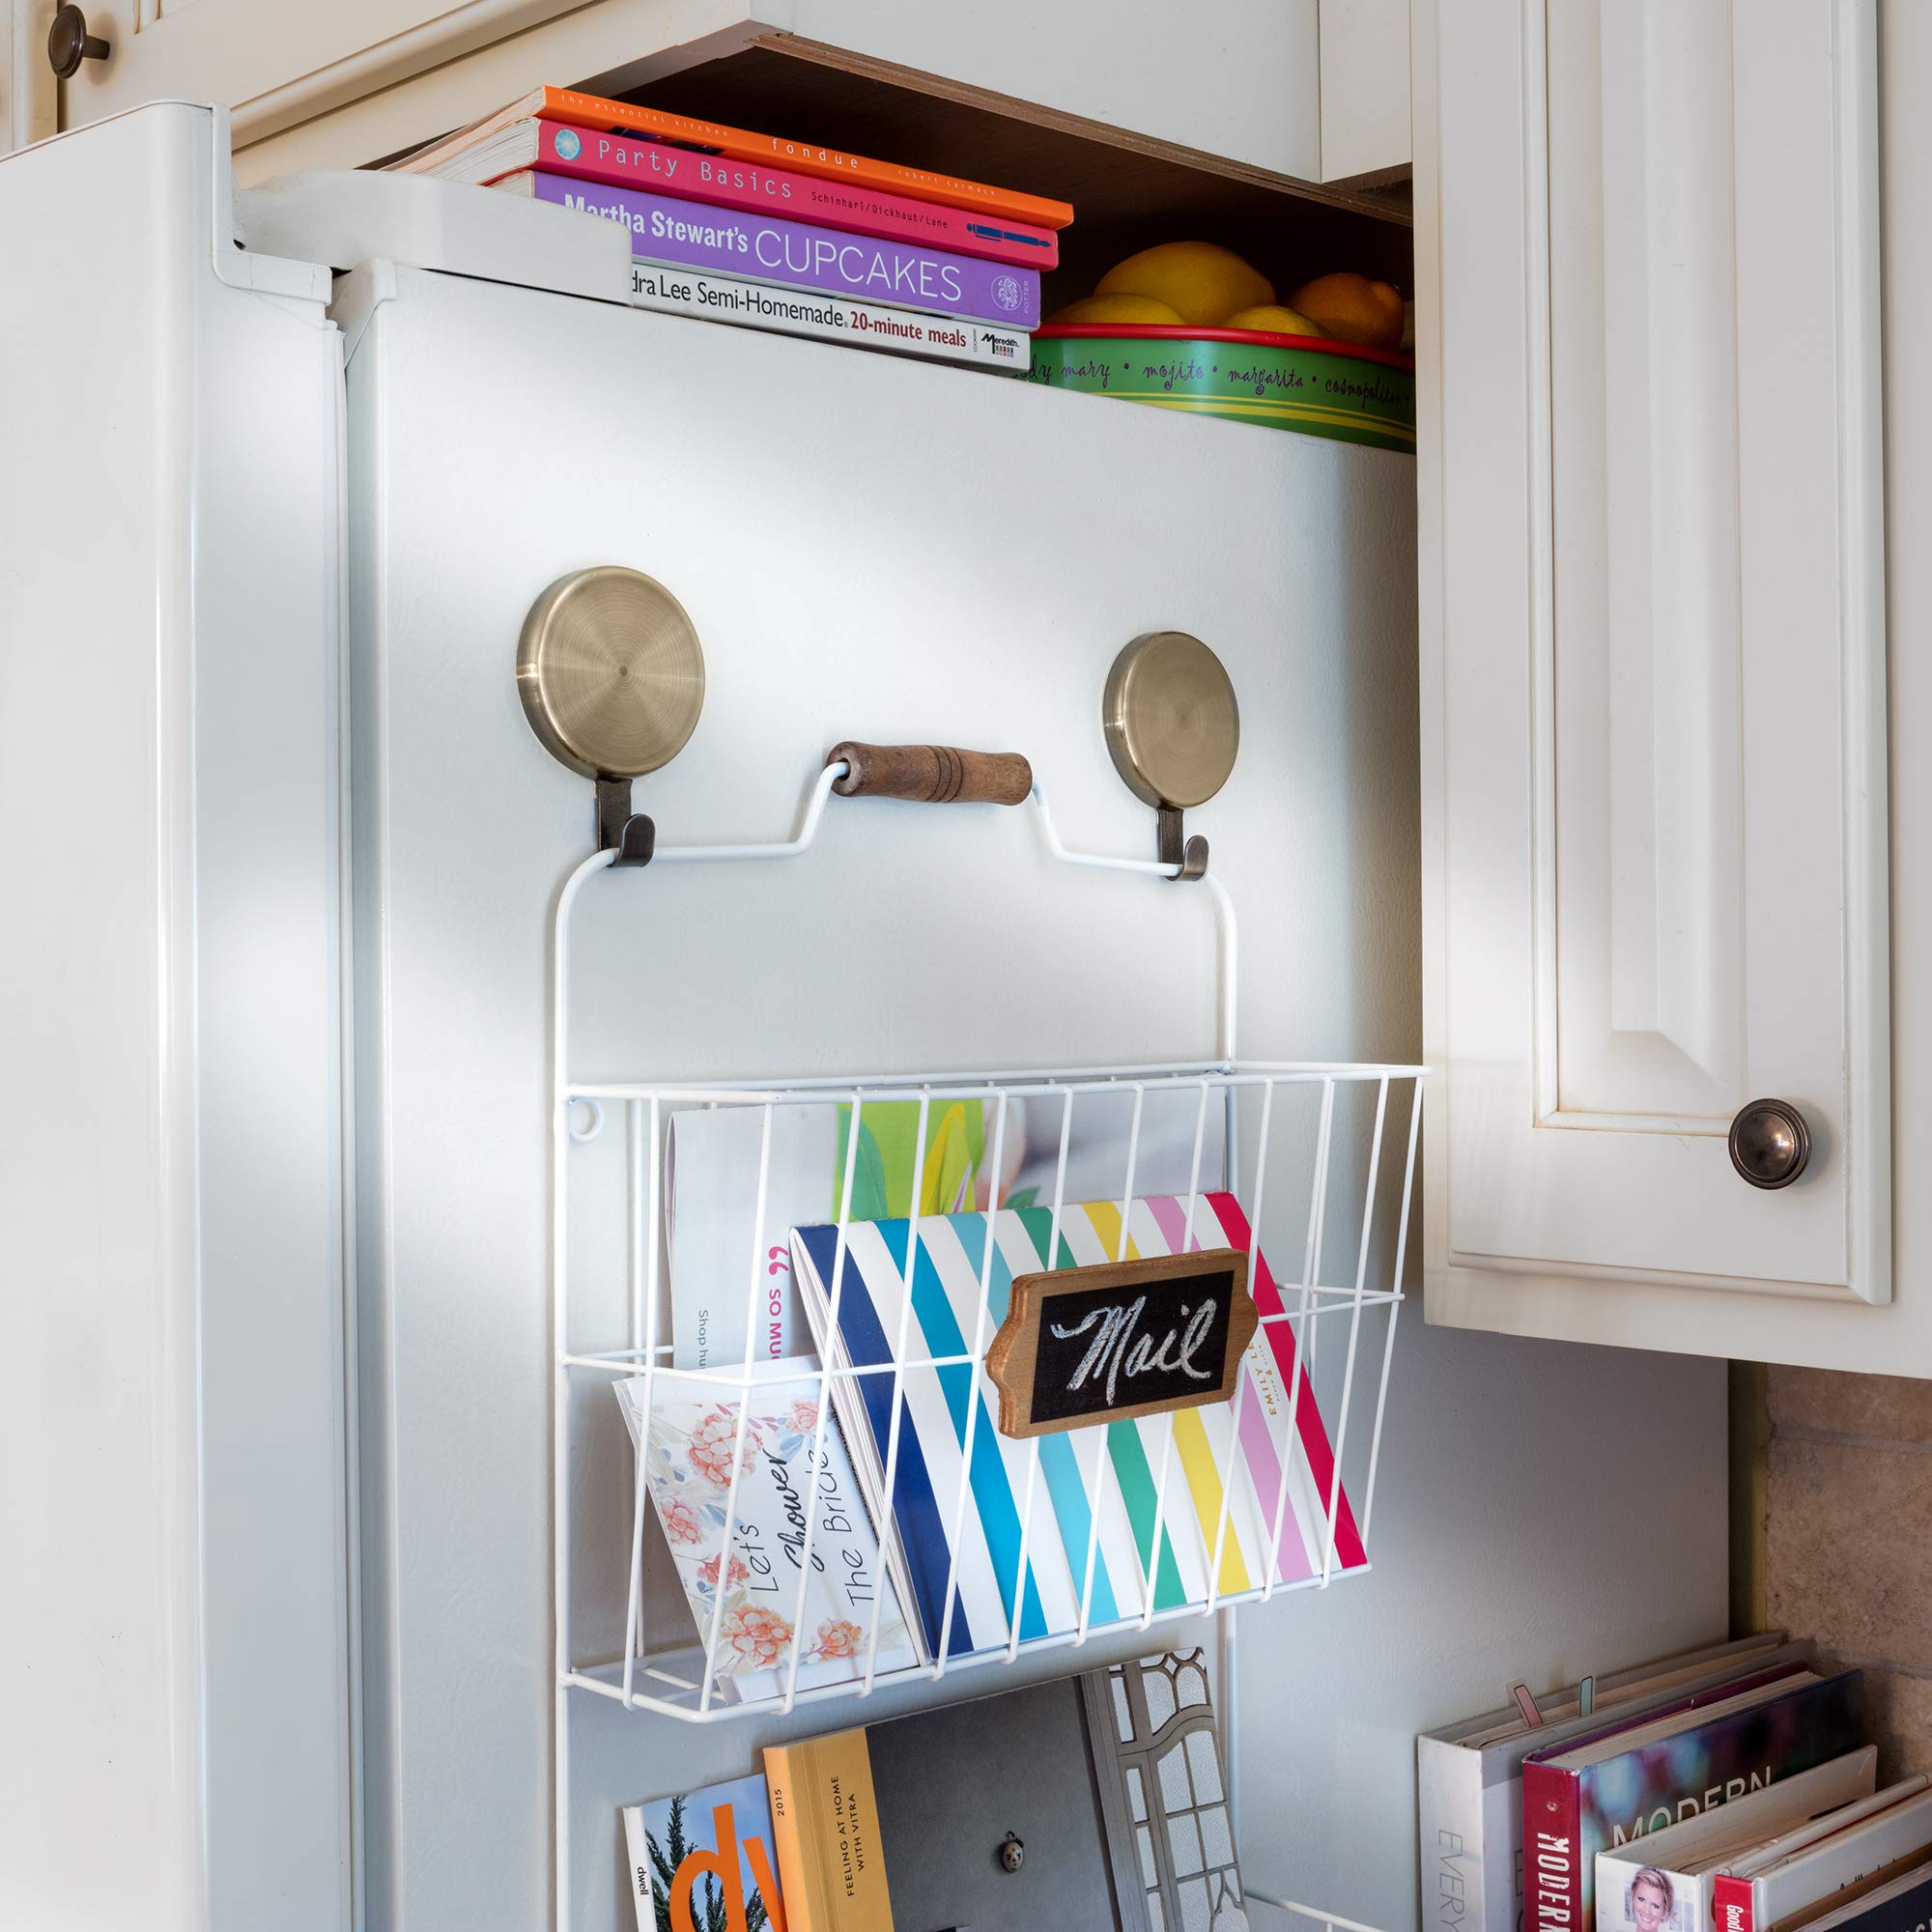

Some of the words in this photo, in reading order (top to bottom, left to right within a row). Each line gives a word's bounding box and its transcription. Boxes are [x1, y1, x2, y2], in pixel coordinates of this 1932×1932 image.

[561, 95, 583, 105] the
[595, 100, 665, 124] essential
[675, 119, 728, 137] kitchen
[773, 138, 858, 168] fondue
[598, 139, 677, 177] Party
[700, 161, 791, 198] Basics
[651, 211, 749, 253] Stewart's
[755, 229, 961, 301] CUPCAKES
[660, 274, 692, 301] Lee
[850, 310, 923, 340] 20-minute
[928, 329, 967, 348] meals
[1062, 360, 1111, 388] mary
[1143, 359, 1204, 389] mojito
[1227, 365, 1304, 395] margarita
[769, 1289, 781, 1317] SO
[696, 1309, 709, 1346] Shop
[698, 1350, 709, 1370] hu
[1050, 1295, 1218, 1406] Mail
[1255, 1368, 1277, 1415] EMILY
[762, 1448, 825, 1573] Shower
[733, 1524, 780, 1592] Let's
[841, 1548, 875, 1607] The
[775, 1788, 785, 1817] 2015
[831, 1776, 843, 1816] HOME
[848, 1793, 860, 1833] VITRA
[837, 1821, 847, 1834] AT
[839, 1840, 856, 1897] FEELING
[854, 1836, 866, 1872] WITH
[637, 1865, 649, 1896] dwell
[1438, 1829, 1464, 1932] EVERY
[1726, 1904, 1745, 1932] Good
